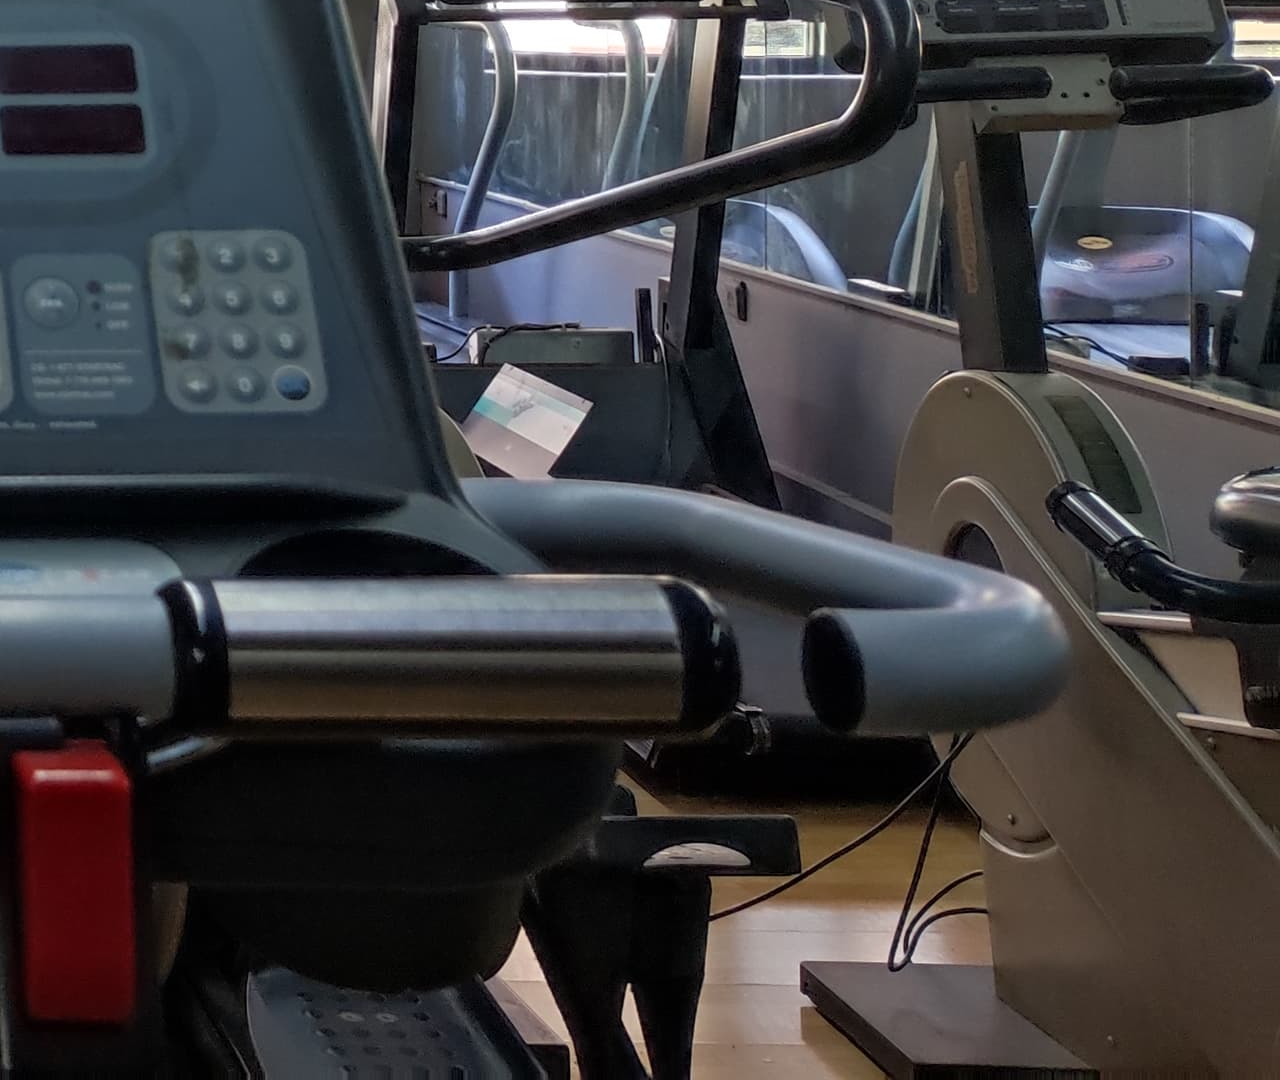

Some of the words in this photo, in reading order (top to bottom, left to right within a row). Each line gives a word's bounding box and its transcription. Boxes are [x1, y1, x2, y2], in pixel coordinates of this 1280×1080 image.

[219, 249, 232, 262] 2
[266, 248, 278, 262] 3
[226, 290, 239, 305] 5
[273, 290, 286, 305] 6
[232, 335, 245, 349] 8
[279, 334, 292, 349] 9
[239, 379, 251, 392] 0
